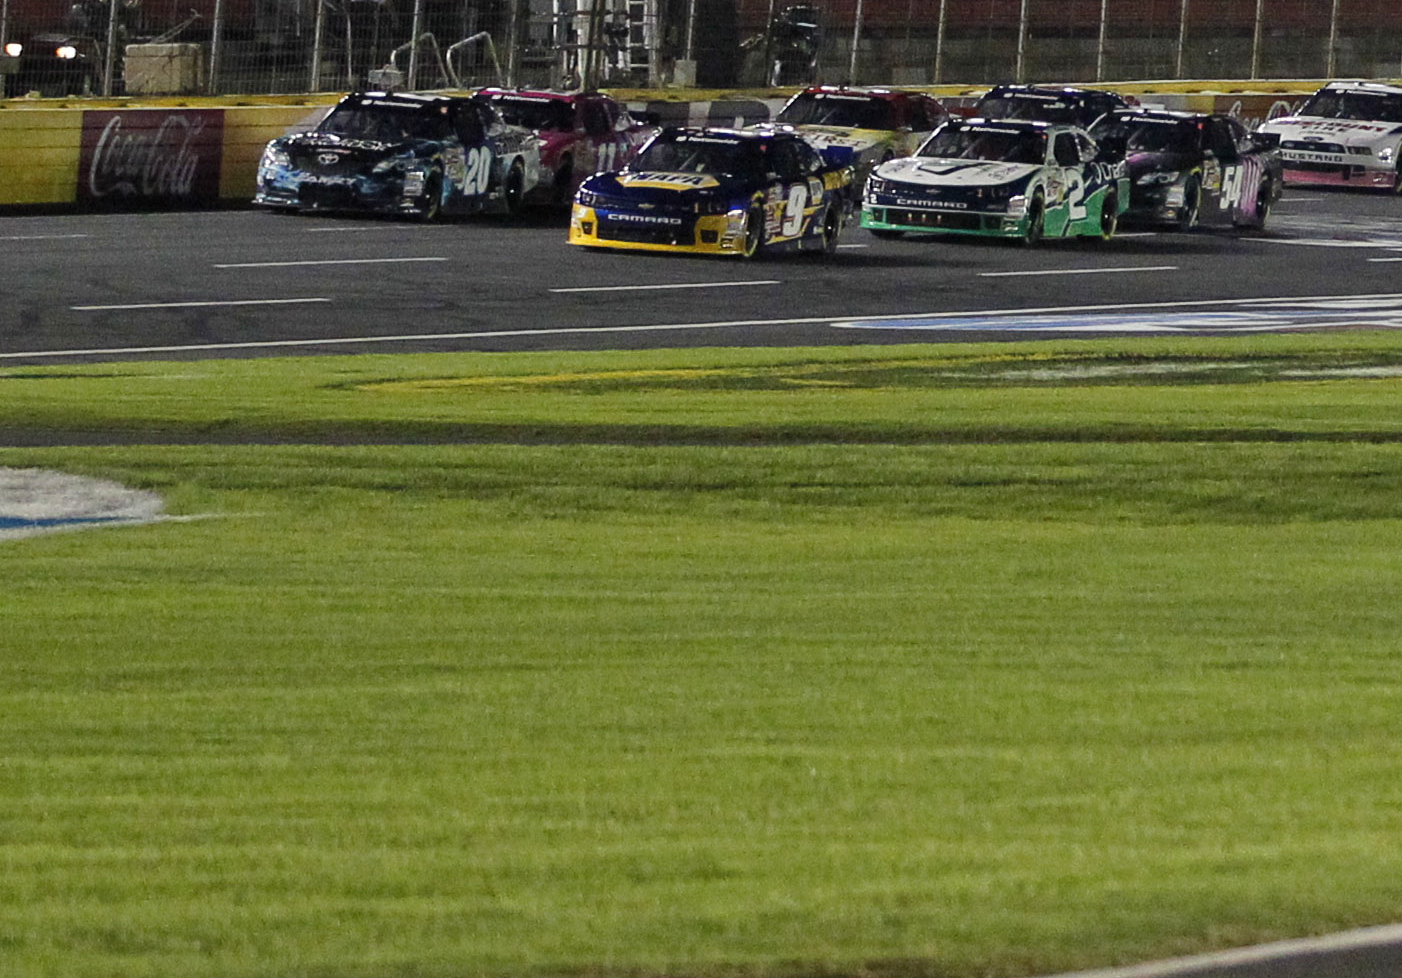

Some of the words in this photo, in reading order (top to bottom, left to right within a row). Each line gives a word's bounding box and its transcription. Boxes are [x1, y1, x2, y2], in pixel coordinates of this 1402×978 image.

[463, 146, 491, 195] 20
[1065, 167, 1087, 220] 2
[1220, 165, 1244, 209] 54
[607, 213, 682, 225] CAMARO
[782, 184, 808, 237] 9
[896, 198, 967, 209] CAMARO
